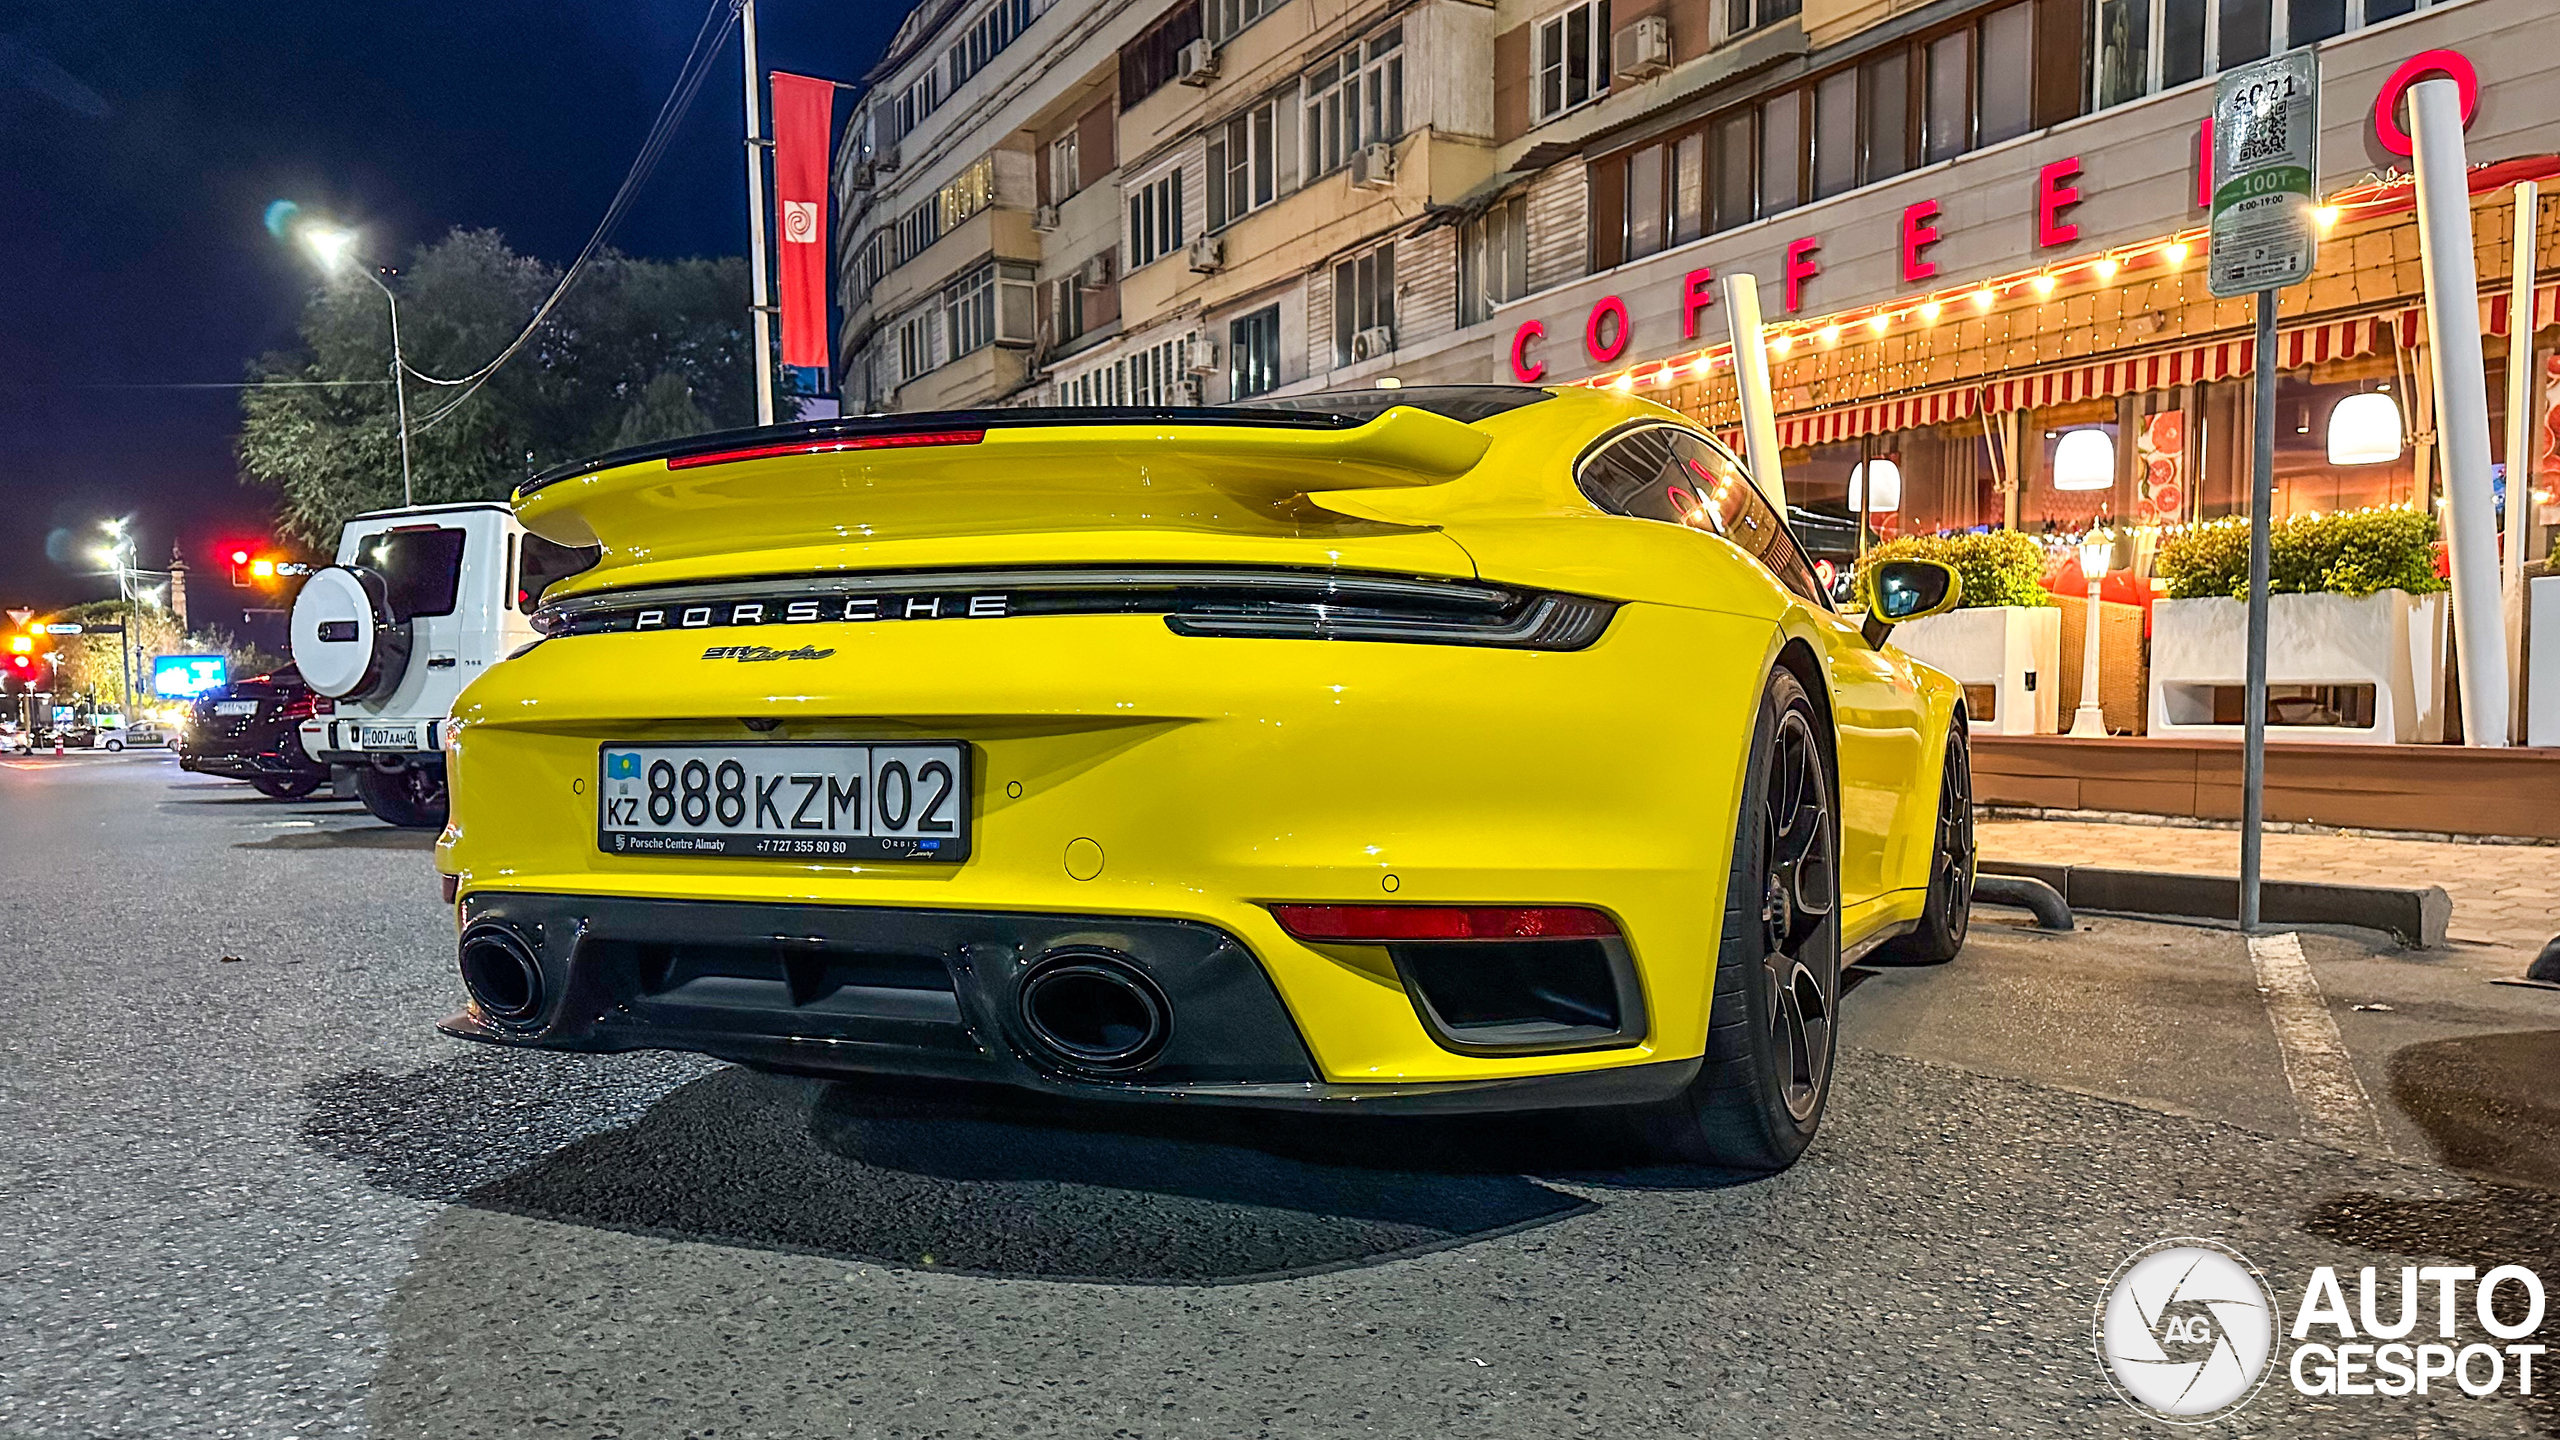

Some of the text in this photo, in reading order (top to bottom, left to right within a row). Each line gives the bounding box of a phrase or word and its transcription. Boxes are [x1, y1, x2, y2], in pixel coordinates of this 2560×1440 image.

[636, 594, 1008, 630] PORSCHE
[607, 797, 639, 826] KZ
[630, 837, 664, 848] Porsche
[665, 838, 693, 849] Centre
[695, 838, 726, 852] Almaty
[756, 839, 771, 851] +7
[773, 840, 792, 852] 727
[794, 840, 814, 853] 355
[816, 841, 830, 853] 80
[832, 841, 847, 854] 80
[881, 838, 918, 850] ORBIS
